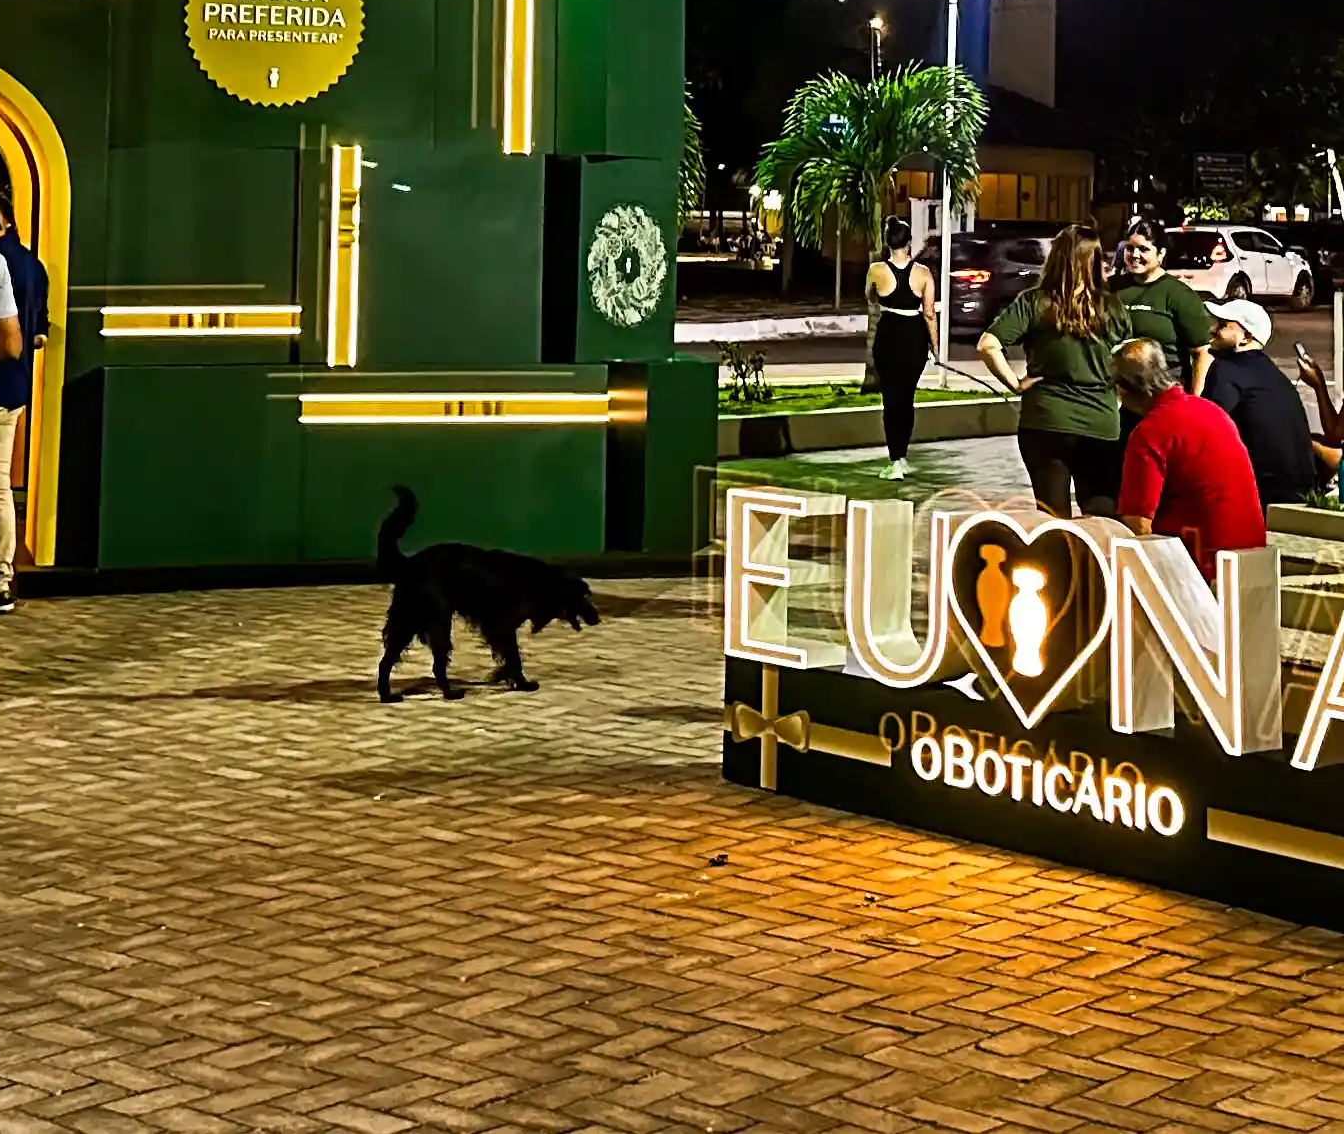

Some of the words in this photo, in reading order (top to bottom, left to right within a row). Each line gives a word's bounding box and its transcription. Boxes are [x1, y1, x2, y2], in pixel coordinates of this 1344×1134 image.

[204, 3, 346, 28] PREFERIDA
[209, 29, 246, 41] PARA
[724, 487, 952, 689] EU
